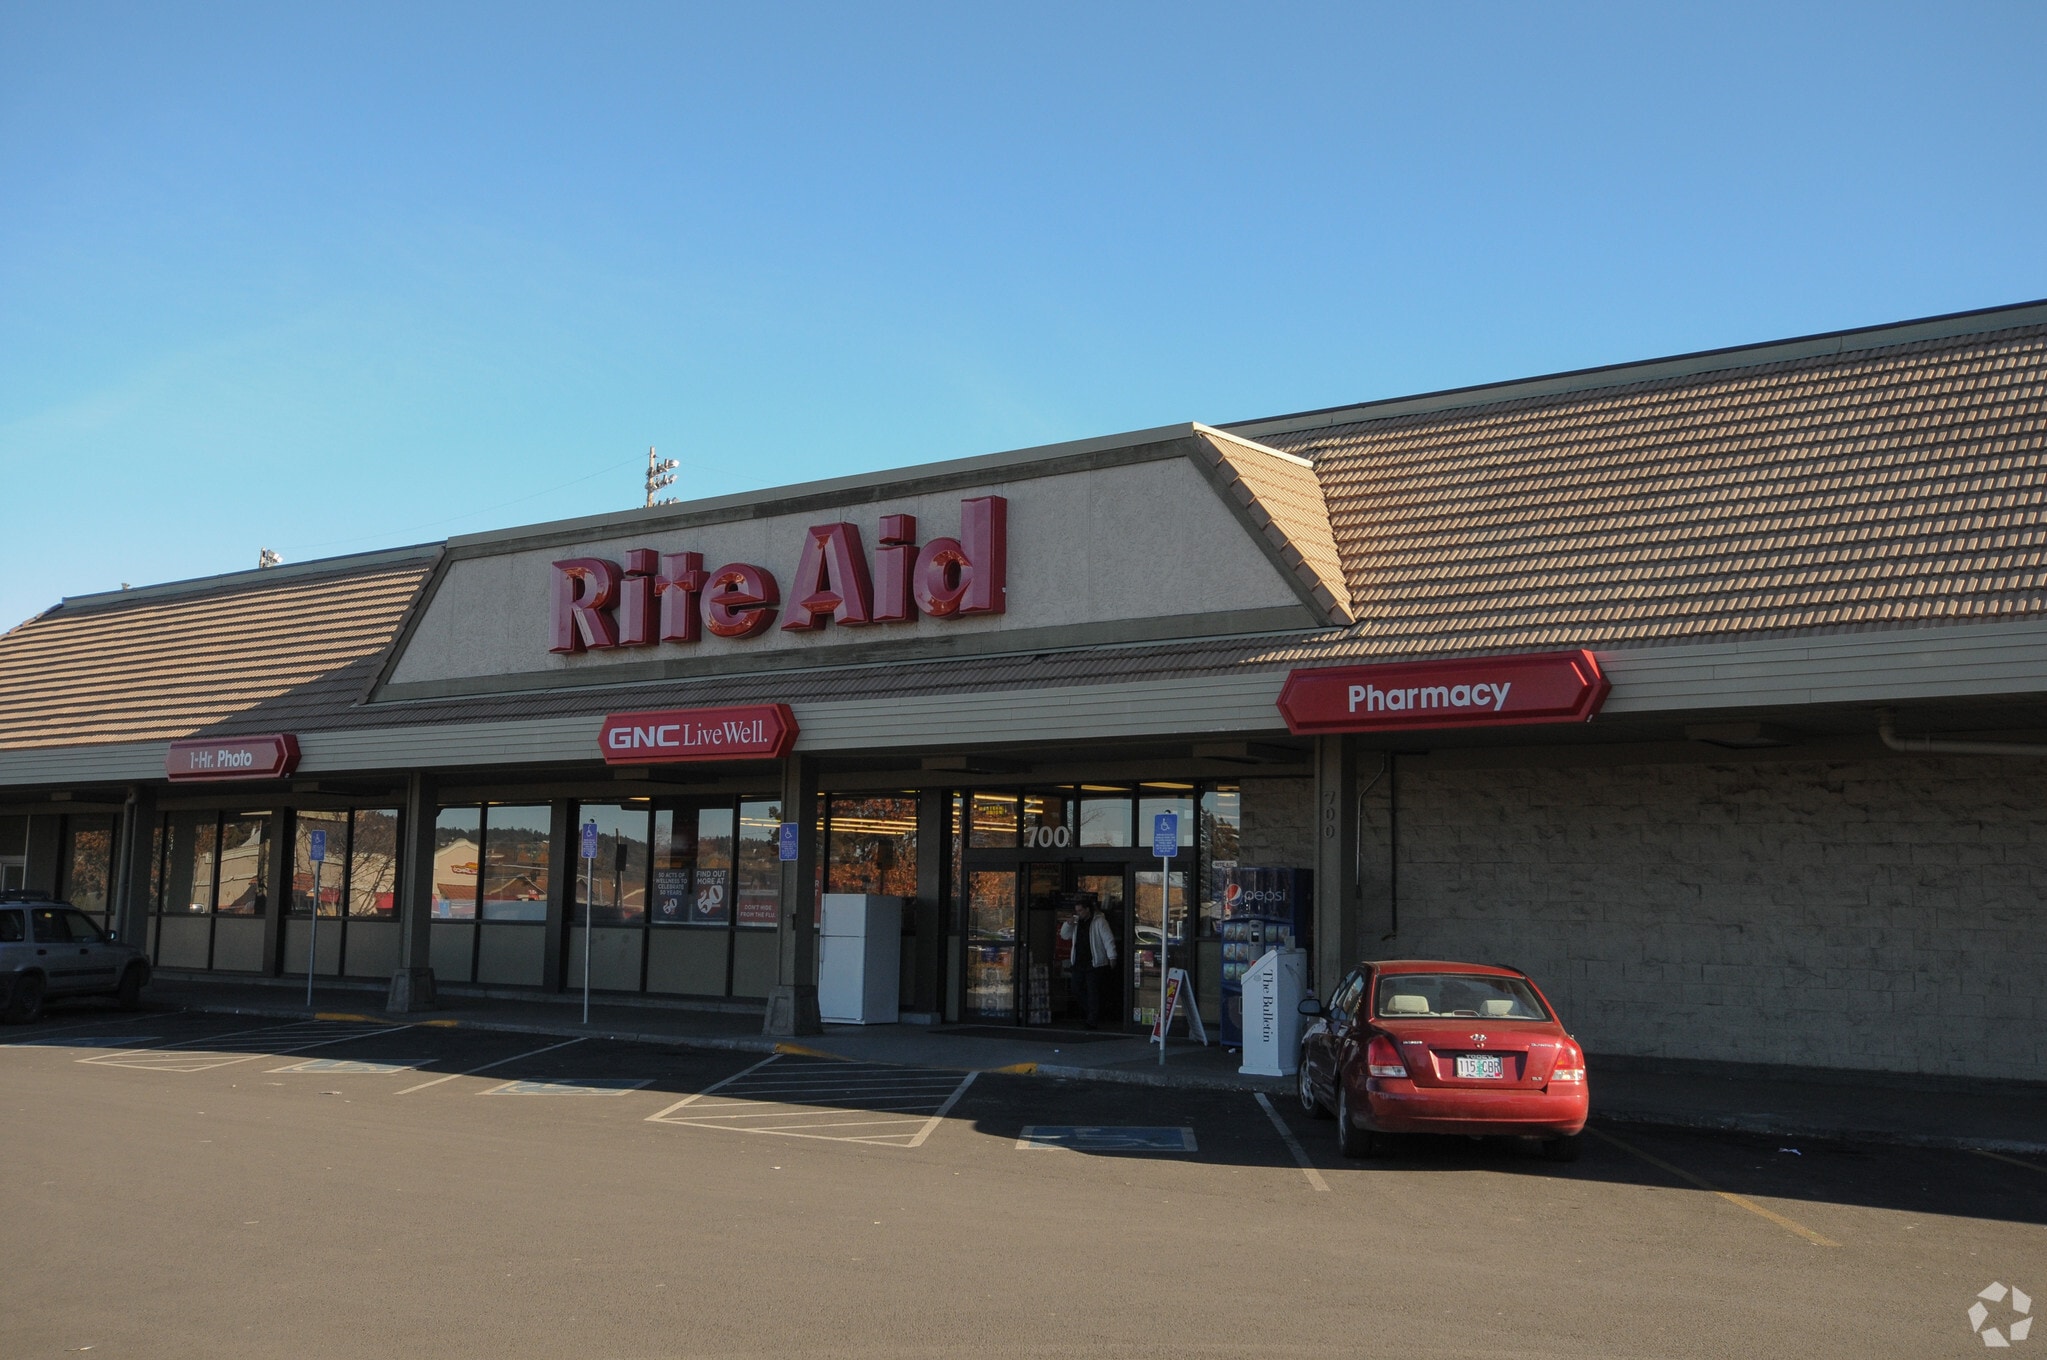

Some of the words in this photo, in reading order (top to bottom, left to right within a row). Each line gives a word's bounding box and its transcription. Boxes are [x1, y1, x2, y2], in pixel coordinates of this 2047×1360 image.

[549, 549, 780, 655] Rite
[781, 495, 1007, 632] Aid
[1348, 682, 1512, 713] Pharmacy
[609, 724, 680, 749] GNC
[190, 751, 214, 769] 1-Hr.
[217, 749, 252, 768] Photo
[1321, 791, 1335, 839] 700
[1026, 825, 1070, 848] 700
[696, 870, 712, 878] FIND
[712, 870, 726, 878] OUT
[1244, 888, 1286, 903] pepsi
[1263, 969, 1274, 994] The
[1263, 996, 1274, 1042] Bulletin
[1460, 1060, 1476, 1073] 115
[1482, 1060, 1501, 1074] CBR
